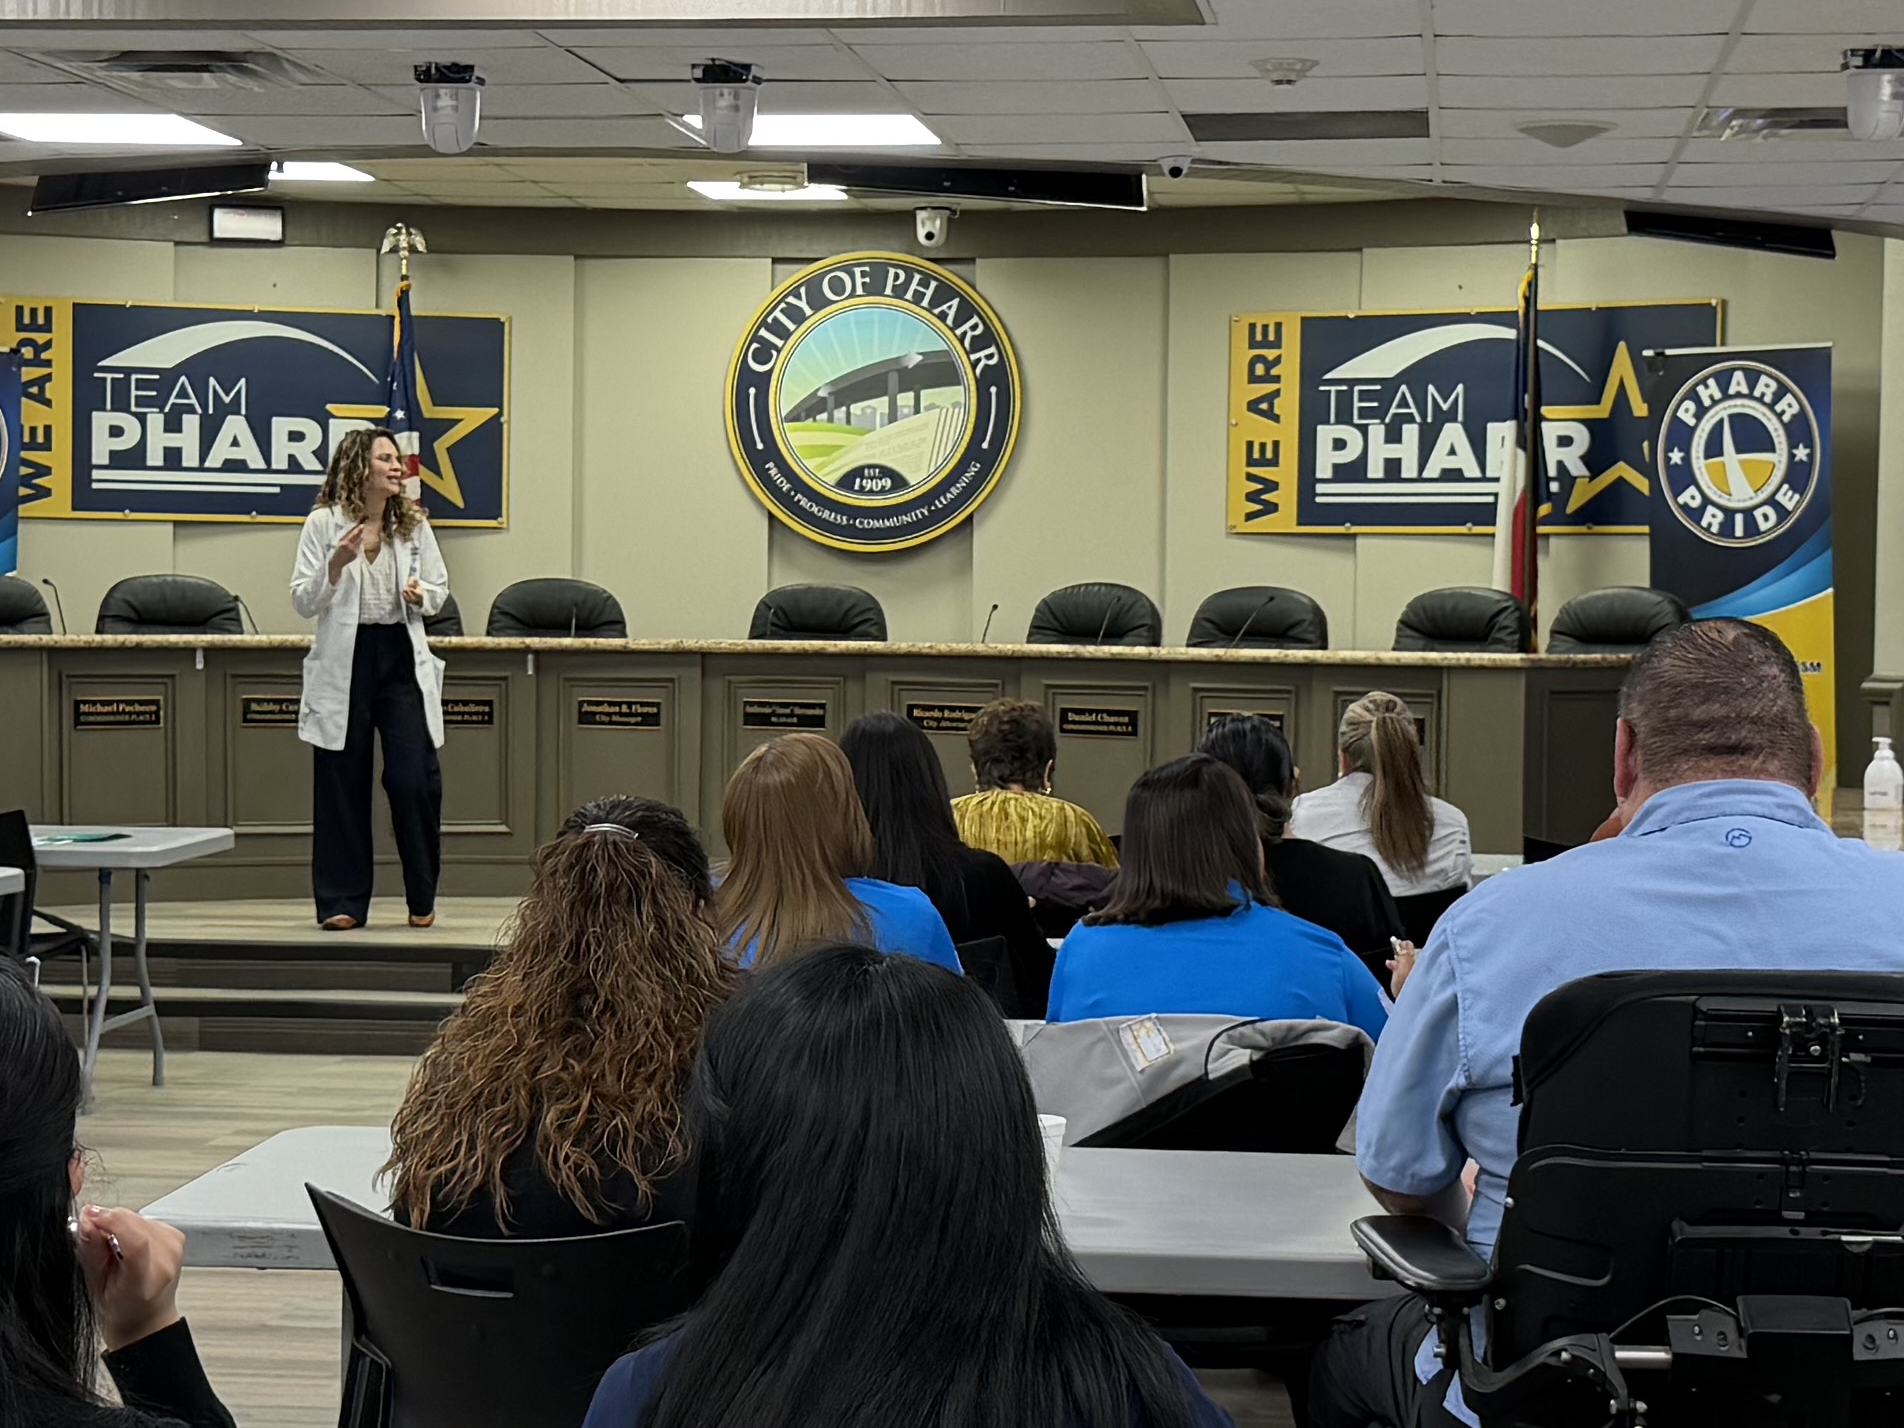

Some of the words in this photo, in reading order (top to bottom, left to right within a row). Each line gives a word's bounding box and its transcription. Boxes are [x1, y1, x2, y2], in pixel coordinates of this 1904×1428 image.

[747, 285, 817, 373] CITY
[821, 266, 871, 301] OF
[884, 267, 1000, 377] PHARR
[15, 304, 54, 409] ARE
[1247, 322, 1283, 424] ARE
[93, 372, 246, 416] TEAM
[1318, 382, 1464, 424] TEAM
[1676, 370, 1800, 427] PHARR
[17, 424, 54, 505] WE
[764, 461, 790, 495] PRIDE
[793, 493, 849, 526] PROGRESS
[855, 505, 930, 529] COMMUNITY
[934, 460, 981, 509] LEARNING
[853, 477, 891, 491] 1909
[1244, 439, 1280, 522] WE
[1677, 483, 1800, 537] PRIDE
